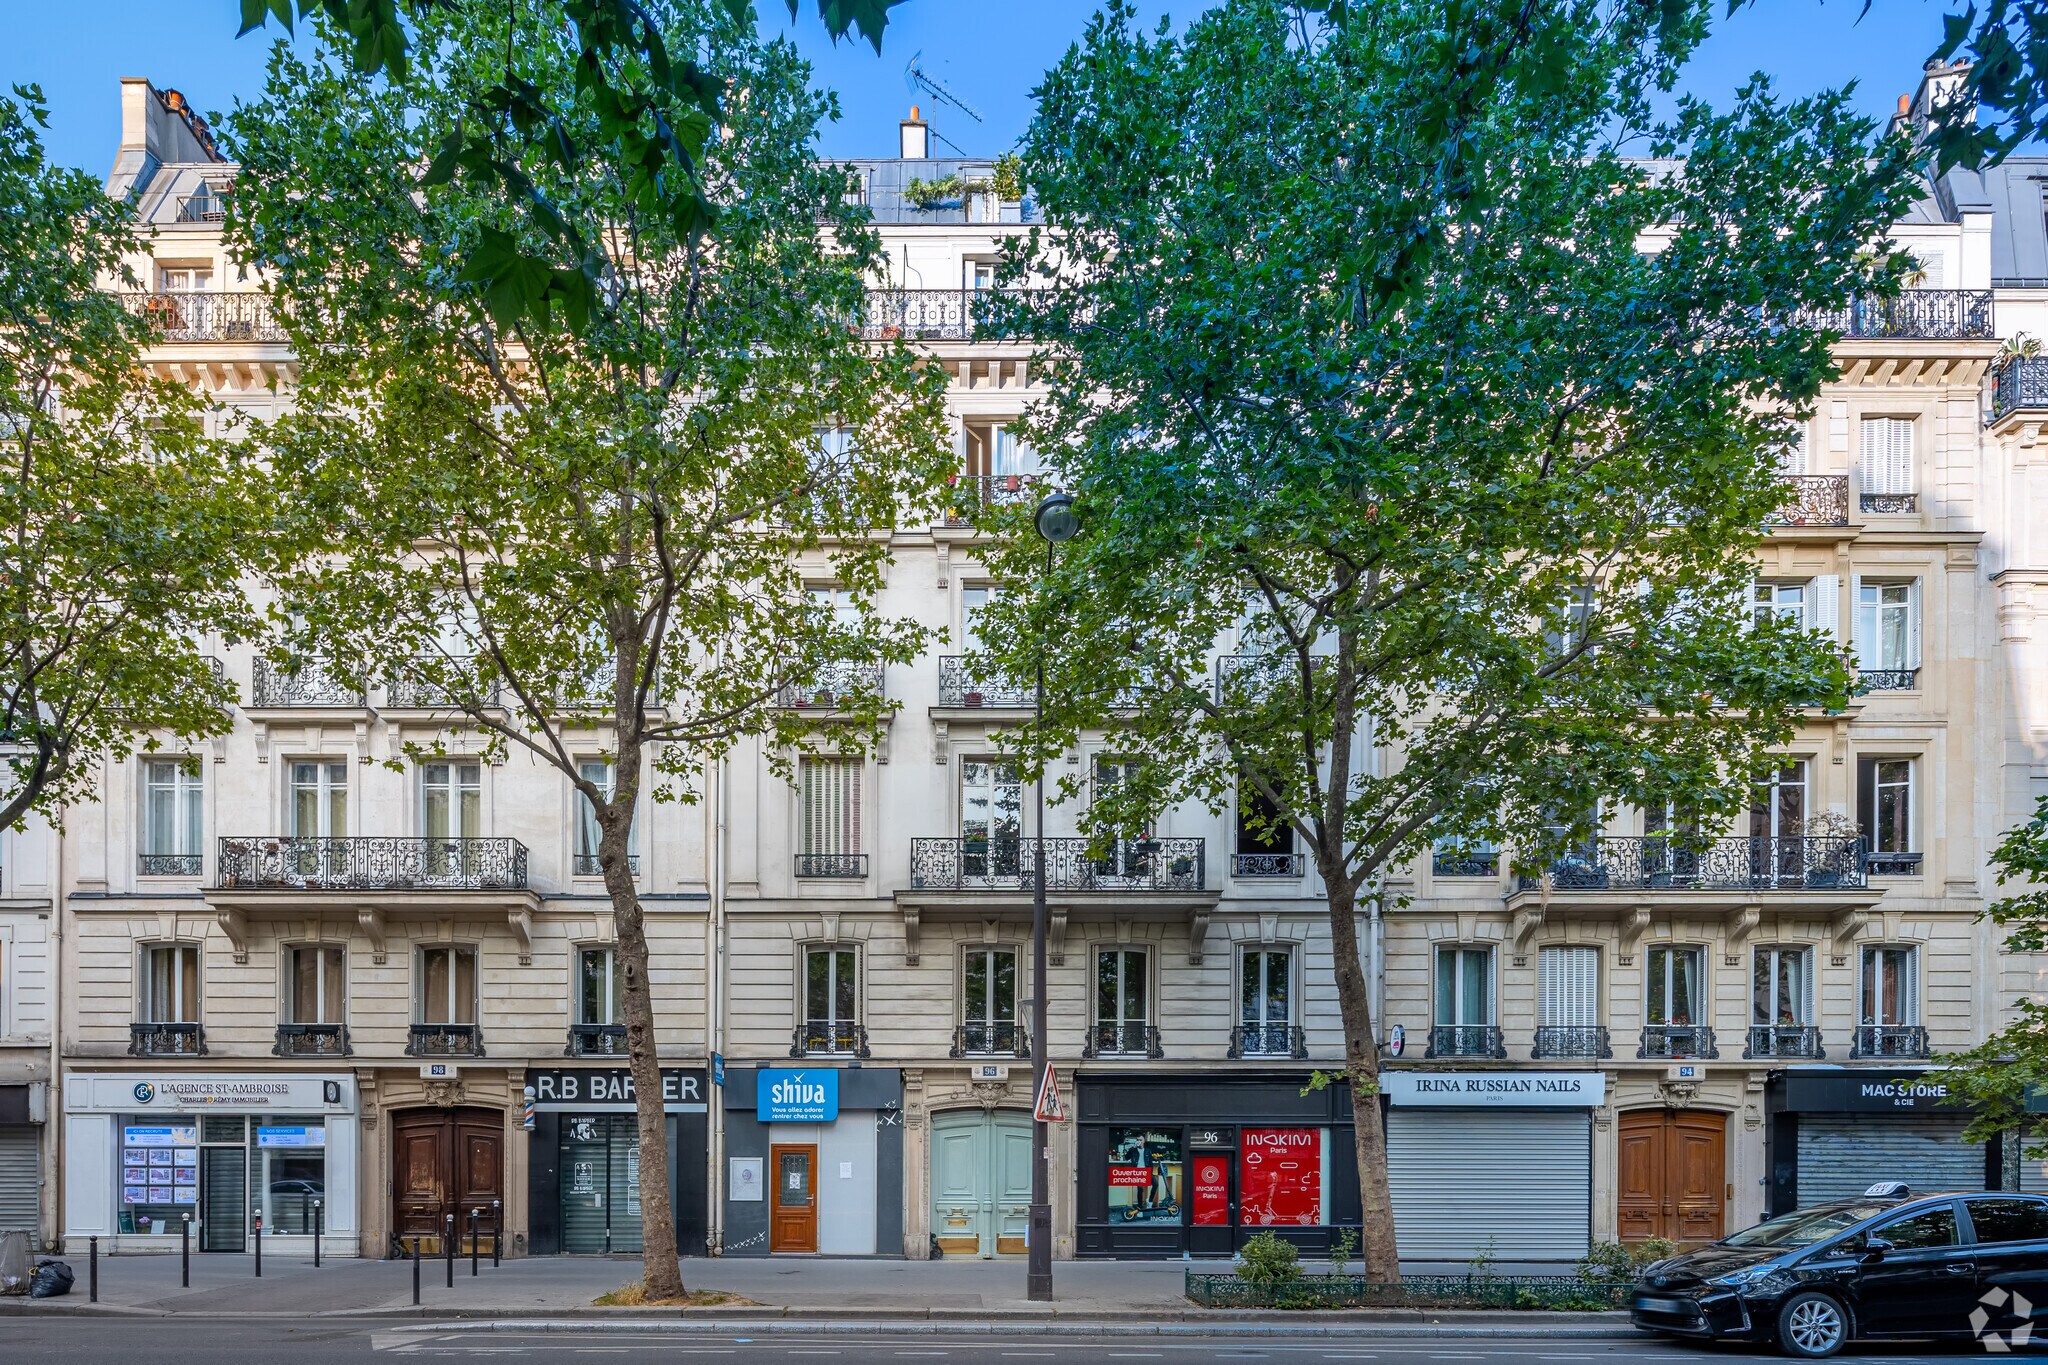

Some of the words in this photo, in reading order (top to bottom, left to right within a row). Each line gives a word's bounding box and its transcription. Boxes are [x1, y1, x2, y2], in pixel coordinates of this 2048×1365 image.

[433, 1066, 444, 1074] 98
[985, 1067, 995, 1075] 96
[1681, 1067, 1692, 1075] 94
[160, 1083, 213, 1094] L'AGENCE
[215, 1083, 289, 1094] ST-AMBROISE
[538, 1076, 578, 1099] R.B
[590, 1076, 700, 1099] BARER
[771, 1078, 826, 1104] shiva
[1416, 1080, 1461, 1092] IRINA
[1465, 1080, 1531, 1092] RUSSIAN
[1535, 1080, 1581, 1092] NAILS
[1862, 1084, 1895, 1097] MAC
[1894, 1098, 1901, 1106] &
[1901, 1098, 1914, 1106] CIE
[1204, 1131, 1218, 1144] 96
[1246, 1134, 1311, 1146] INOKIM
[1112, 1176, 1147, 1184] prochaine
